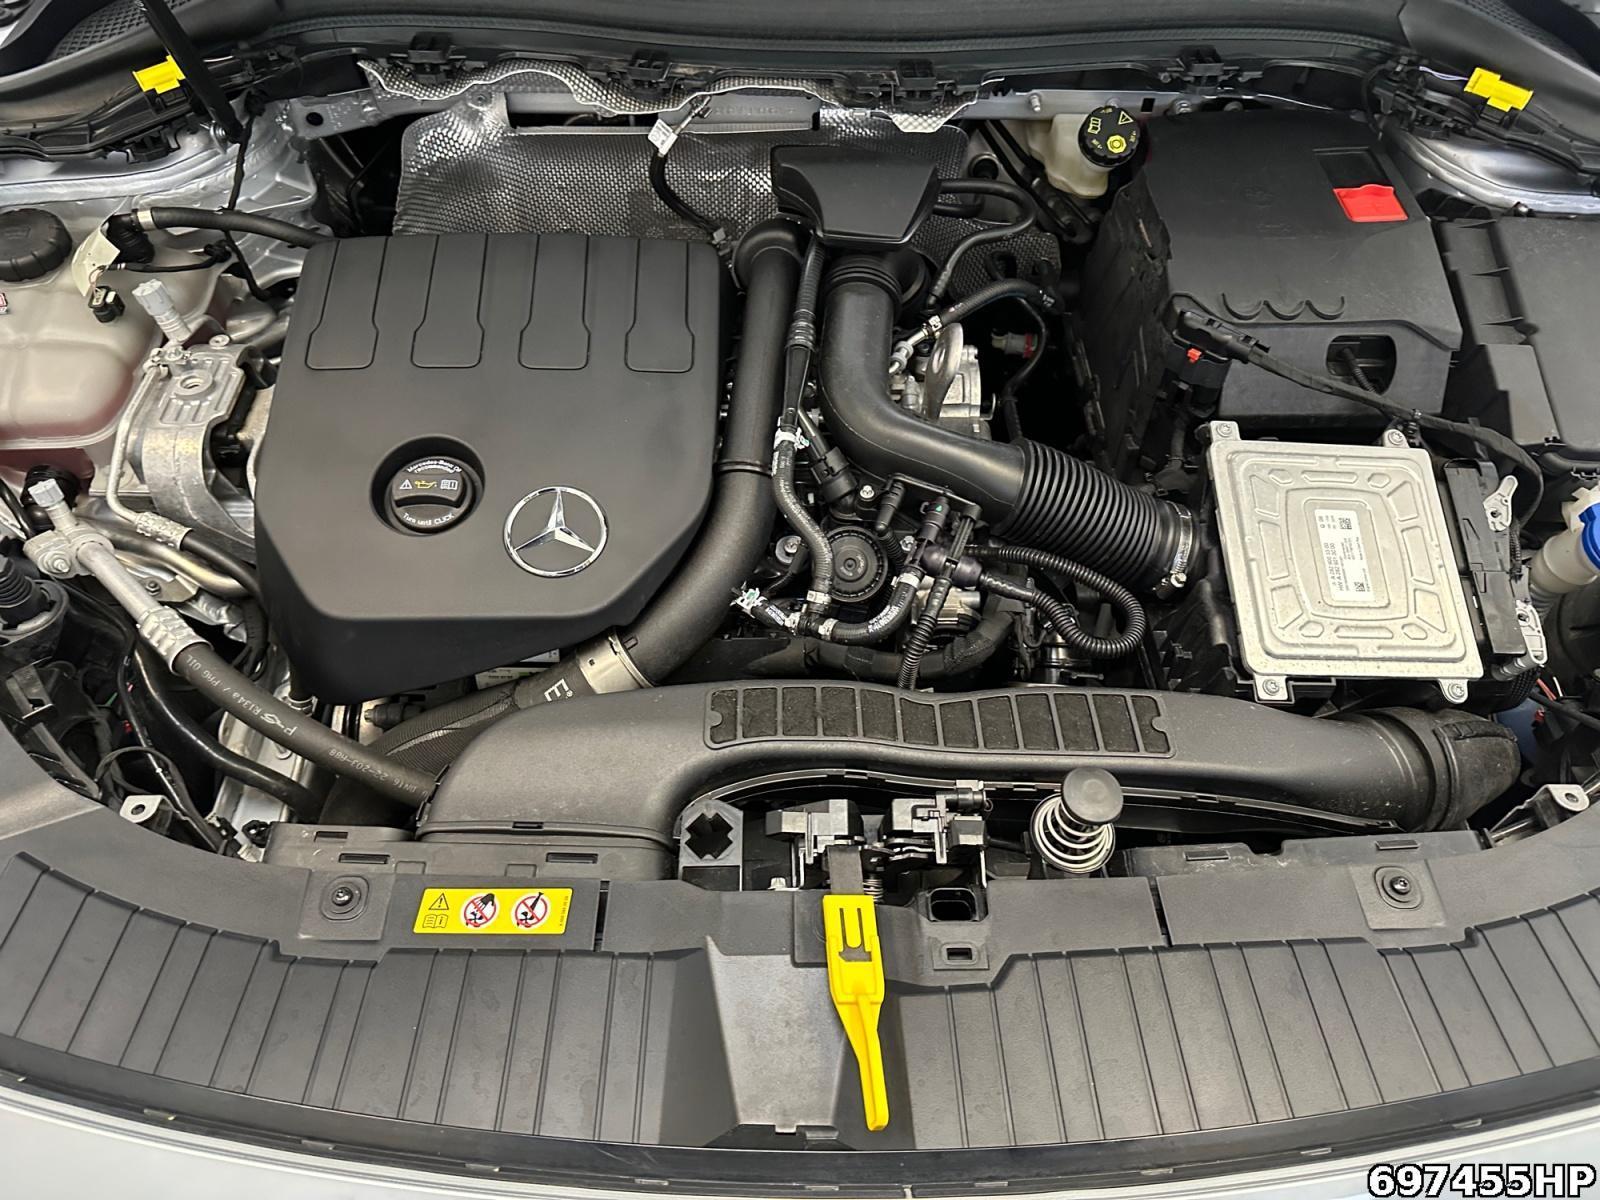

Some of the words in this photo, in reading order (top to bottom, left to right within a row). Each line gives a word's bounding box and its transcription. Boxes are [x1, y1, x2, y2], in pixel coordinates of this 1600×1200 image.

[403, 512, 416, 523] Turn
[434, 512, 454, 524] CLICK
[186, 654, 202, 670] OIL
[202, 670, 220, 687] PAG
[233, 692, 262, 715] R134a
